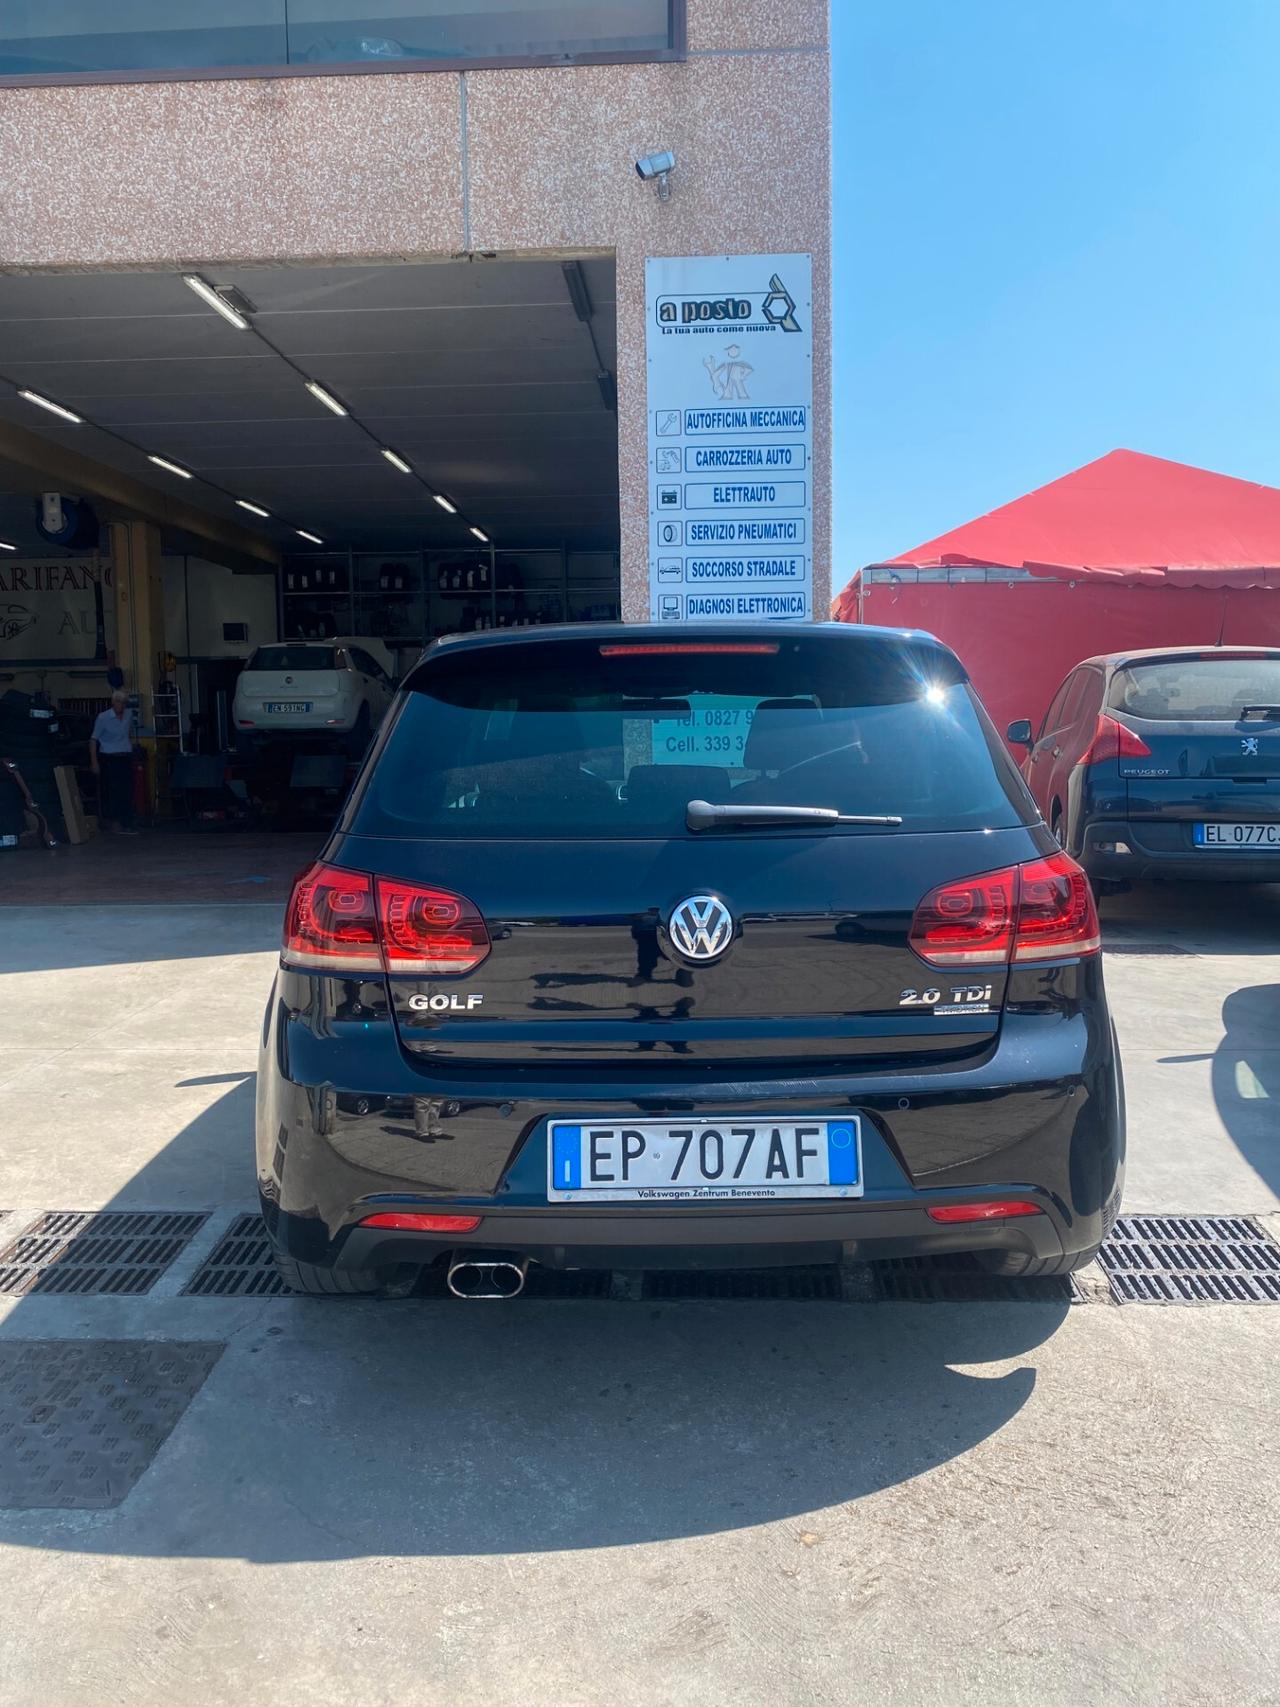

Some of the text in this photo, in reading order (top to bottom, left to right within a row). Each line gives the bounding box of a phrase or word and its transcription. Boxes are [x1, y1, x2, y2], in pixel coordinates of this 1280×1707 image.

[660, 298, 752, 324] a posto
[674, 327, 691, 335] tua
[692, 326, 714, 334] auto
[746, 325, 777, 333] nuova
[686, 410, 805, 429] AUTOFFICINA MECCANICA
[695, 448, 792, 467] CARROZZERIA AUTO
[713, 486, 776, 503] ELETTRAUTO
[691, 523, 797, 540] SERVIZIO PNEUMATICI
[692, 560, 796, 577] SOCCORSO STRADALE
[689, 597, 803, 615] DIAGNOSI ELETTRONICA
[704, 710, 740, 726] 0827
[665, 736, 700, 752] Cell.
[704, 735, 731, 751] 339
[1123, 768, 1171, 776] PEUGEOT
[1206, 825, 1227, 842] EL
[1233, 825, 1280, 842] 077C
[408, 994, 484, 1010] GOLF
[899, 987, 941, 1005] 2.0
[589, 1130, 646, 1182] EP
[668, 1127, 820, 1181] 707AF
[637, 1188, 776, 1199] Volkswagen Zentrum Benevento
